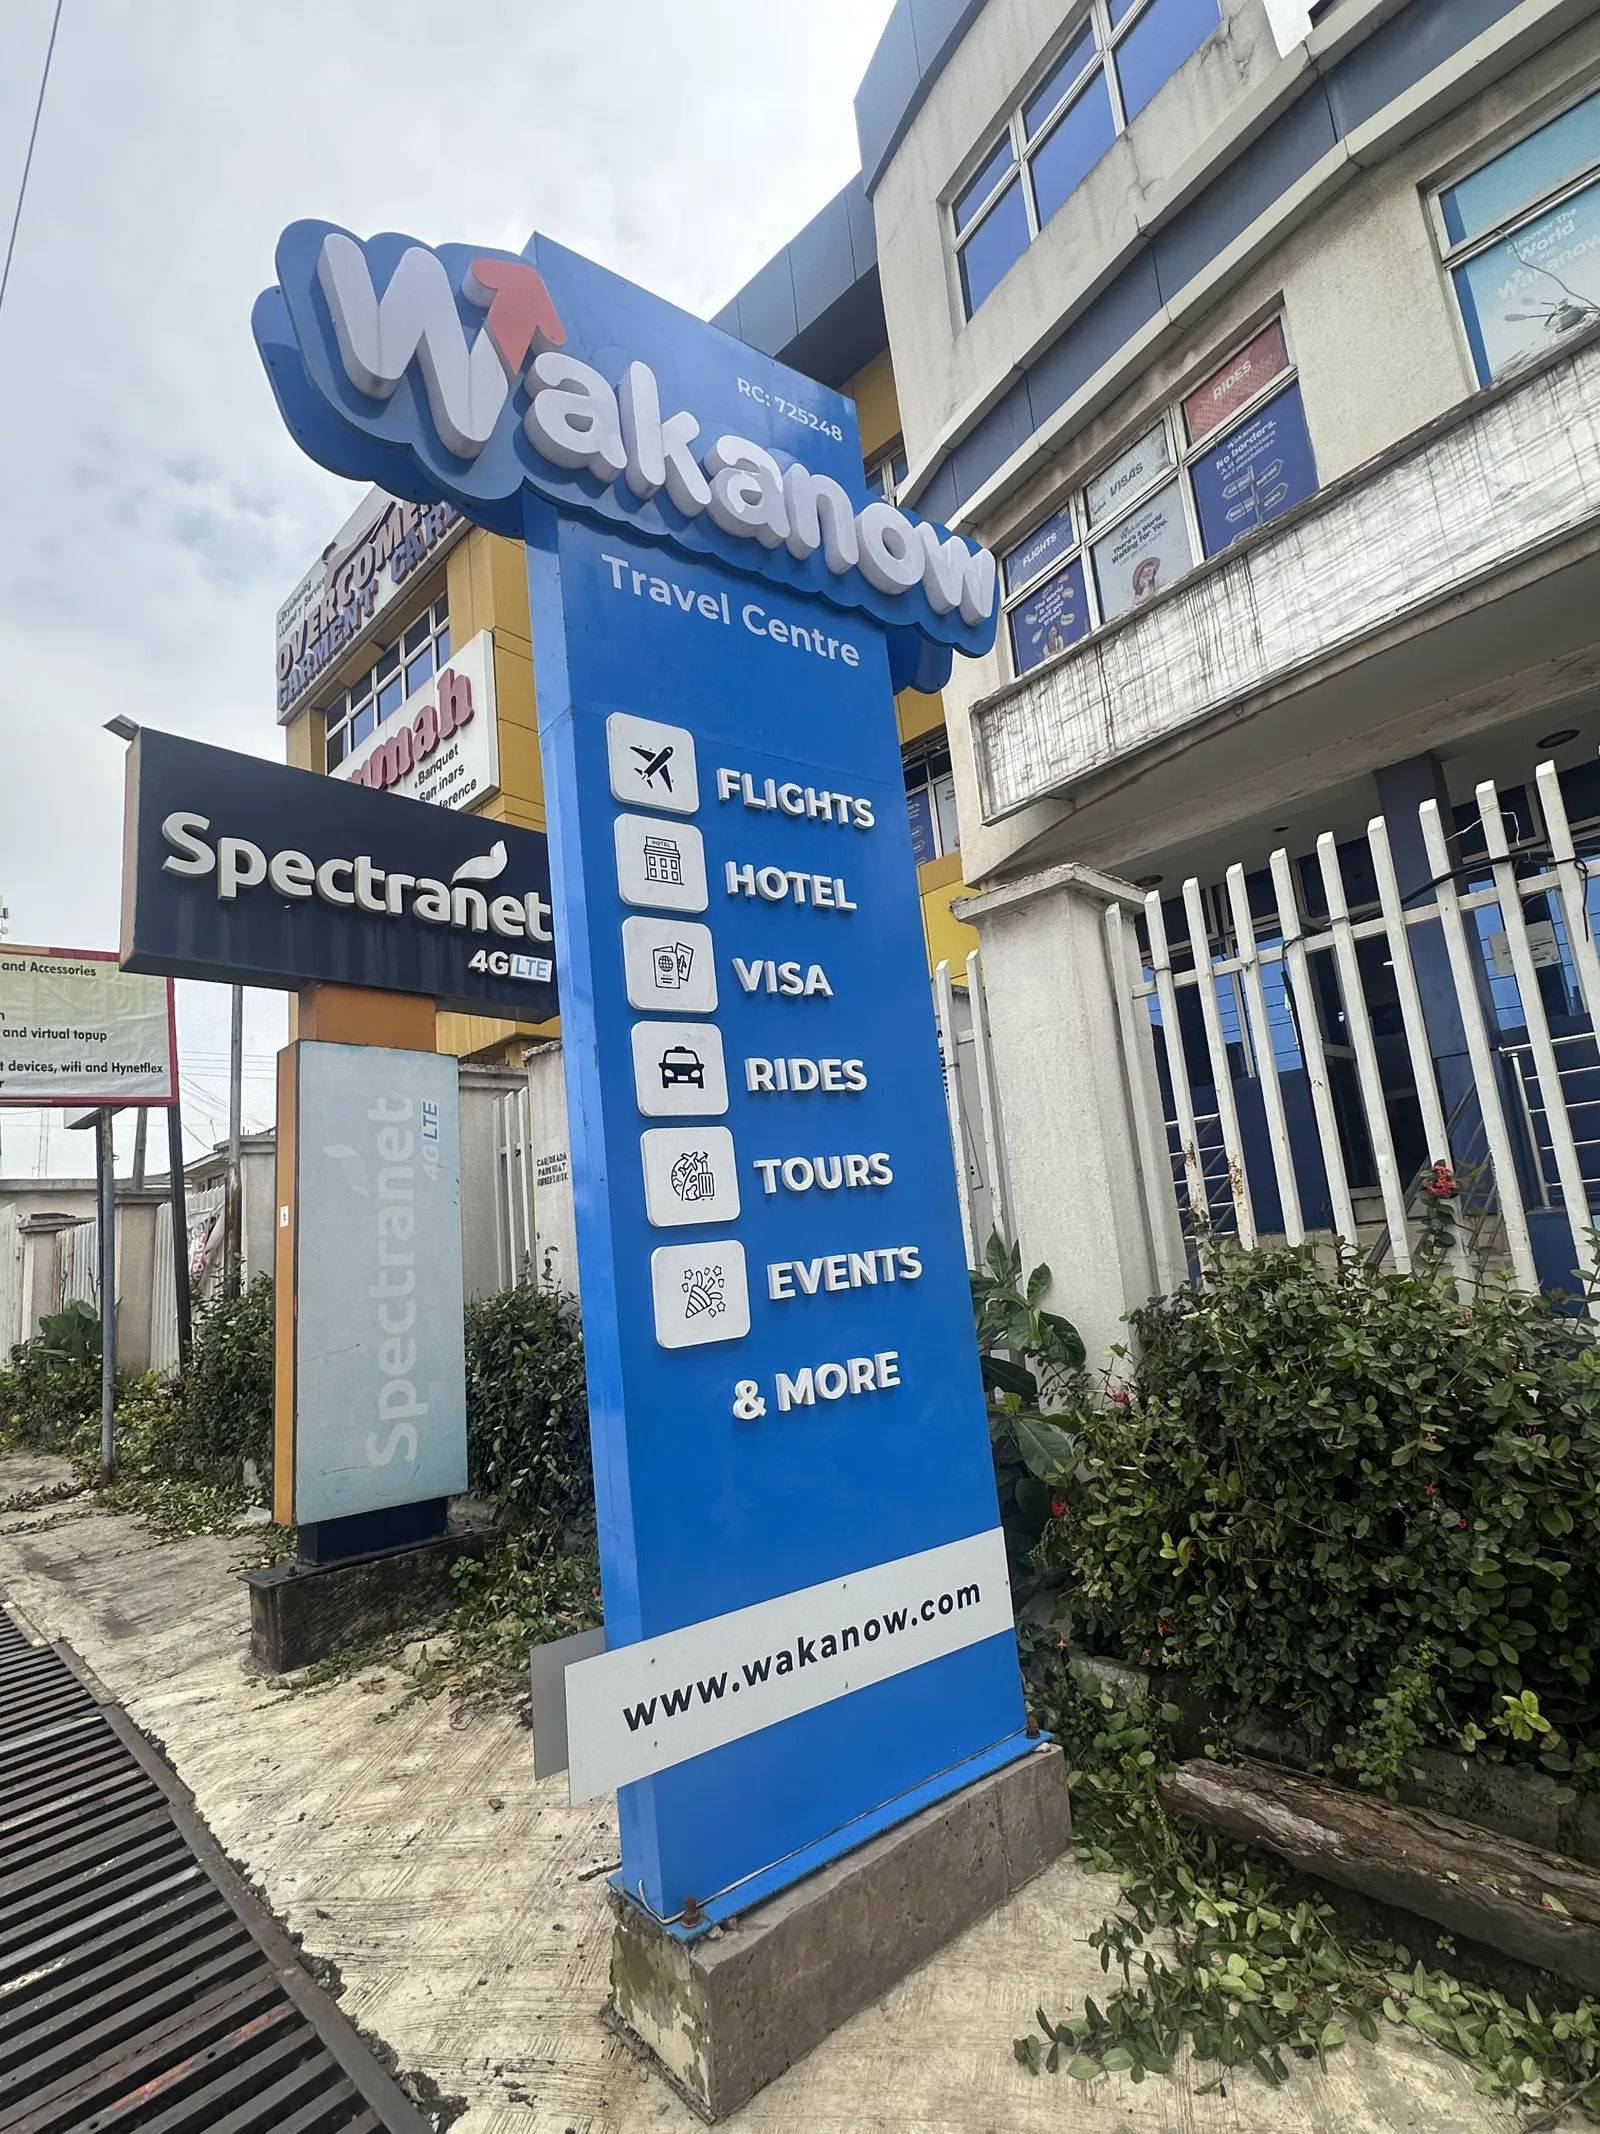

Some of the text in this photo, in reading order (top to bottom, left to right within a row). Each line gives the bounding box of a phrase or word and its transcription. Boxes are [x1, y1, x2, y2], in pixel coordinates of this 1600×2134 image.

[1507, 208, 1577, 254] Discover The
[1519, 219, 1575, 261] World
[1213, 360, 1252, 401] RIDES
[317, 232, 996, 627] Wakanow
[737, 377, 843, 442] RC: 725248
[1215, 420, 1277, 470] No borders.
[1110, 462, 1144, 497] VISAS
[1142, 513, 1162, 531] World
[1022, 532, 1057, 567] FLIGHTS
[1111, 541, 1139, 564] Waiting
[1139, 530, 1151, 542] for
[276, 500, 431, 681] OVERCOME
[601, 553, 860, 668] Travel Centre
[277, 577, 379, 711] GARMENT
[417, 743, 460, 786] Banquet
[717, 768, 875, 831] FLIGHTS
[651, 840, 671, 848] HOTEL
[161, 811, 554, 943] Spectranet
[725, 861, 857, 912] HOTEL
[2, 961, 97, 977] and Accessories
[732, 958, 834, 997] VISA
[3, 1027, 107, 1043] and virtual topup
[8, 1060, 57, 1074] devices,
[61, 1060, 82, 1073] wifi
[85, 1061, 108, 1073] and
[111, 1062, 164, 1076] Hynetflex
[744, 1057, 868, 1092] RIDES
[753, 1152, 894, 1194] TOURS
[367, 1097, 429, 1467] Spectranet
[767, 1246, 923, 1300] EVENTS
[733, 1351, 901, 1420] & MORE
[622, 1582, 982, 1733] www.wakanow.com
